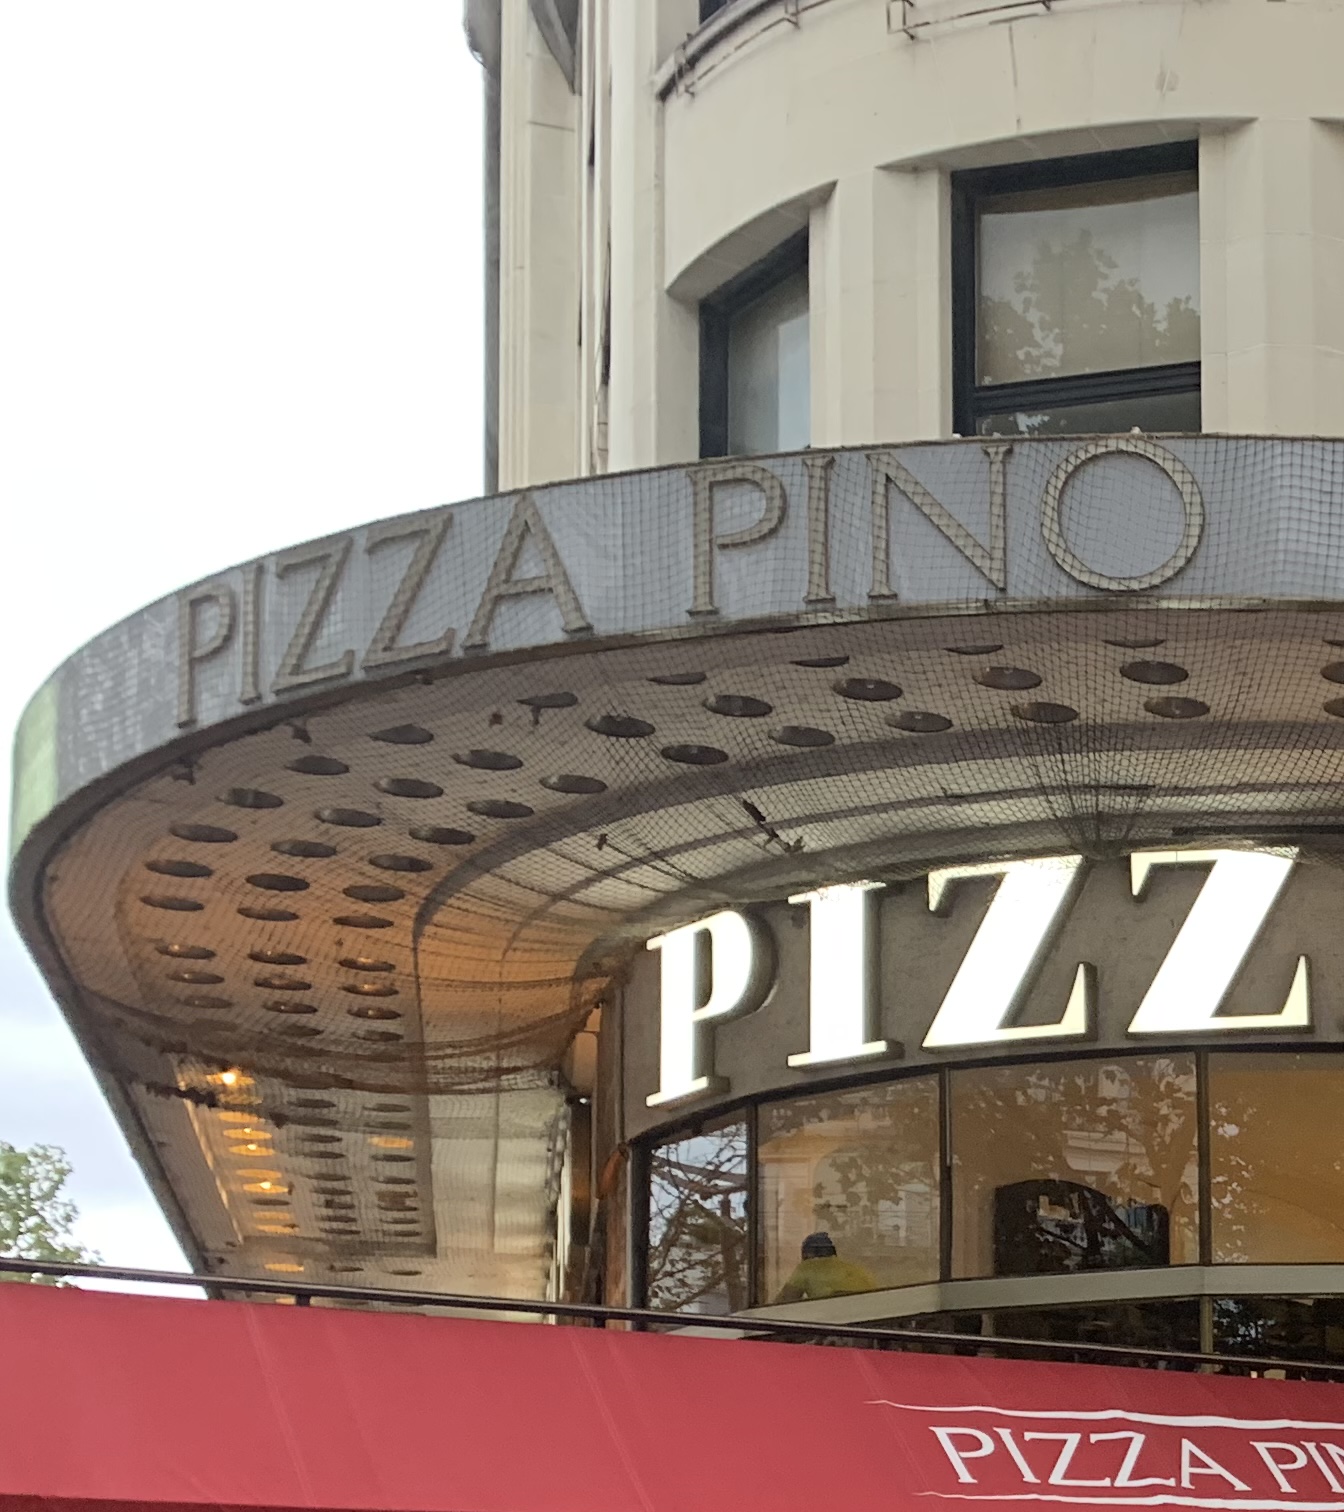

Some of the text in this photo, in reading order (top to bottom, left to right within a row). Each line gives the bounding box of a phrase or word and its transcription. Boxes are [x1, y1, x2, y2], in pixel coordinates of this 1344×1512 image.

[174, 436, 1205, 730] PIZZA PINO
[928, 1424, 1252, 1493] PIZZA
